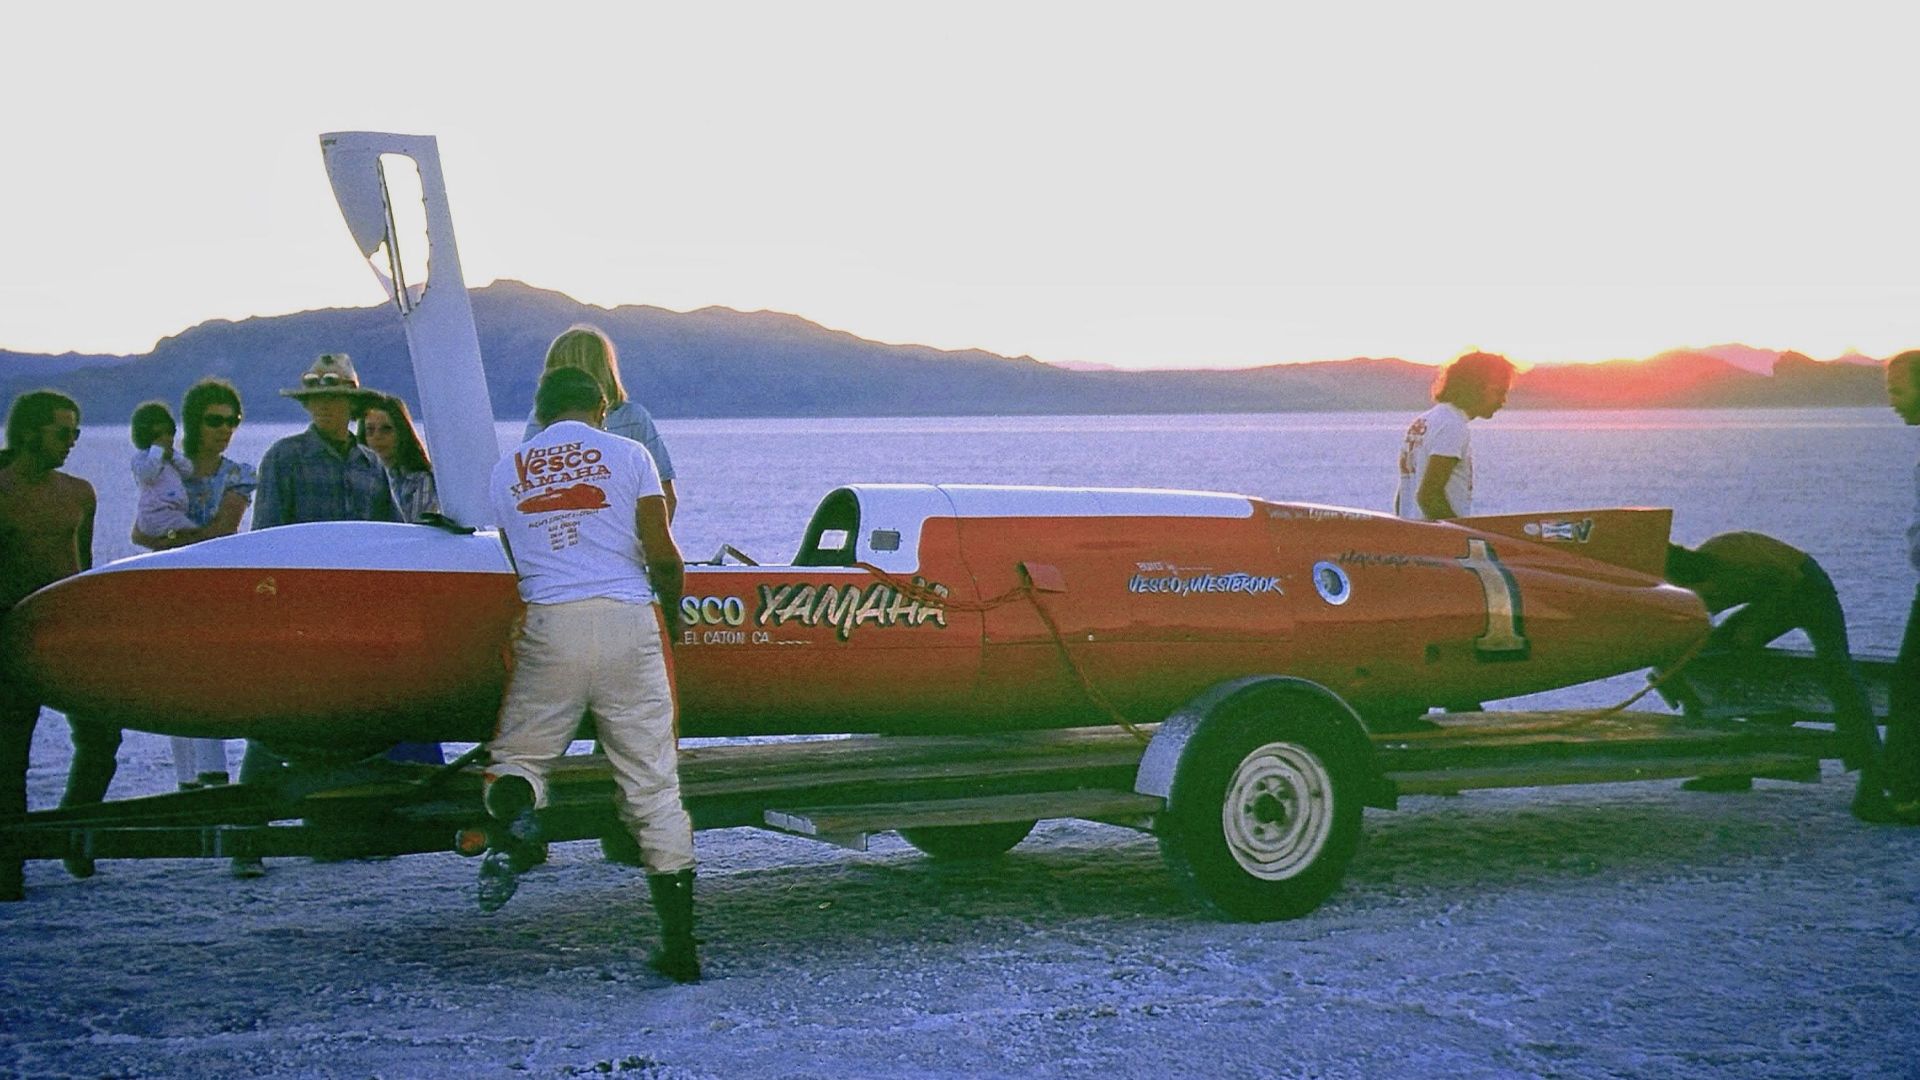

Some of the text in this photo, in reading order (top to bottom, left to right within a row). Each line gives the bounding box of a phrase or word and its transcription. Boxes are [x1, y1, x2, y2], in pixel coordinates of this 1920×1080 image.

[530, 442, 583, 457] DON
[1128, 574, 1181, 594] VESCO
[1189, 572, 1284, 596] WESTBROOK
[680, 577, 949, 641] SCO YAMAHA
[683, 631, 701, 645] EL
[751, 631, 770, 645] CA
